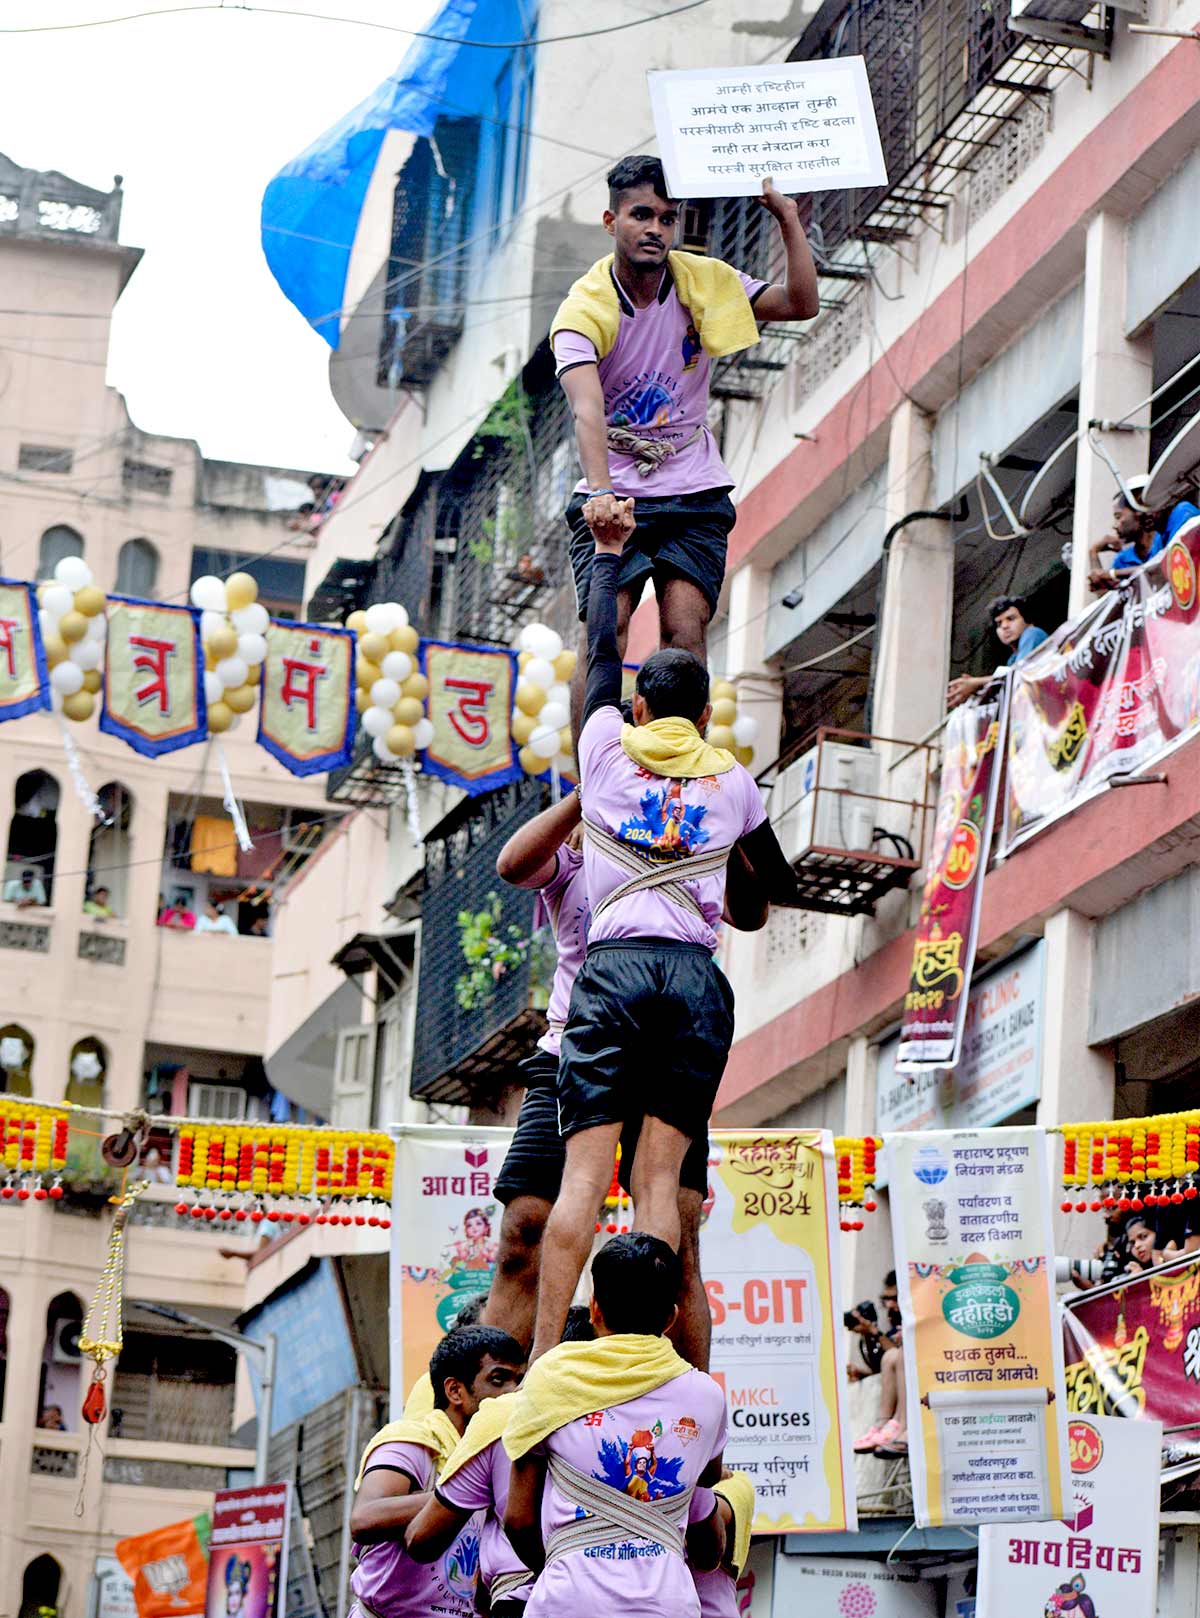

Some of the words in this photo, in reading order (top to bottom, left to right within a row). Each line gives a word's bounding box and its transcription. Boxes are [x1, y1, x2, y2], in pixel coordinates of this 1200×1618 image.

[716, 82, 751, 95] आम्ही
[731, 104, 752, 114] एक
[756, 101, 800, 112] आव्हान
[807, 96, 837, 113] तुम्ही
[680, 123, 744, 136] परस्त्रीसाठी
[749, 120, 787, 133] आपली
[823, 116, 855, 127] बदला
[712, 143, 738, 155] नाही
[742, 145, 758, 153] तर
[762, 140, 803, 152] नेत्रदान
[807, 139, 830, 149] करा
[708, 162, 744, 174] परस्त्री
[748, 160, 793, 177] सुरक्षित
[798, 156, 840, 170] राहतील
[625, 828, 652, 841] 2024
[953, 1147, 995, 1160] महाराष्ट्र
[997, 1146, 1029, 1161] प्रदूषण
[955, 1163, 994, 1176] नियंत्रण
[997, 1163, 1024, 1174] मंडळ
[744, 1191, 811, 1216] 2024
[958, 1195, 1001, 1208] पर्यावरण
[1003, 1196, 1012, 1206] व
[960, 1211, 1019, 1225] वातावरणीय
[961, 1231, 985, 1243] बदल
[988, 1228, 1022, 1241] विभाग
[950, 1298, 1014, 1327] दहीहंडी
[944, 1348, 982, 1362] पथक
[935, 1368, 993, 1384] पथनाट्य
[997, 1364, 1038, 1381] आमचे!
[731, 1388, 778, 1406] MKCL
[732, 1409, 810, 1428] Courses
[945, 1417, 960, 1426] एक
[968, 1457, 1018, 1469] पर्यावरणपूरक
[952, 1472, 991, 1482] गणेशोत्सव
[993, 1472, 1016, 1481] साजरा
[756, 1479, 787, 1497] कोर्स
[1008, 1536, 1142, 1574] आयडियल
